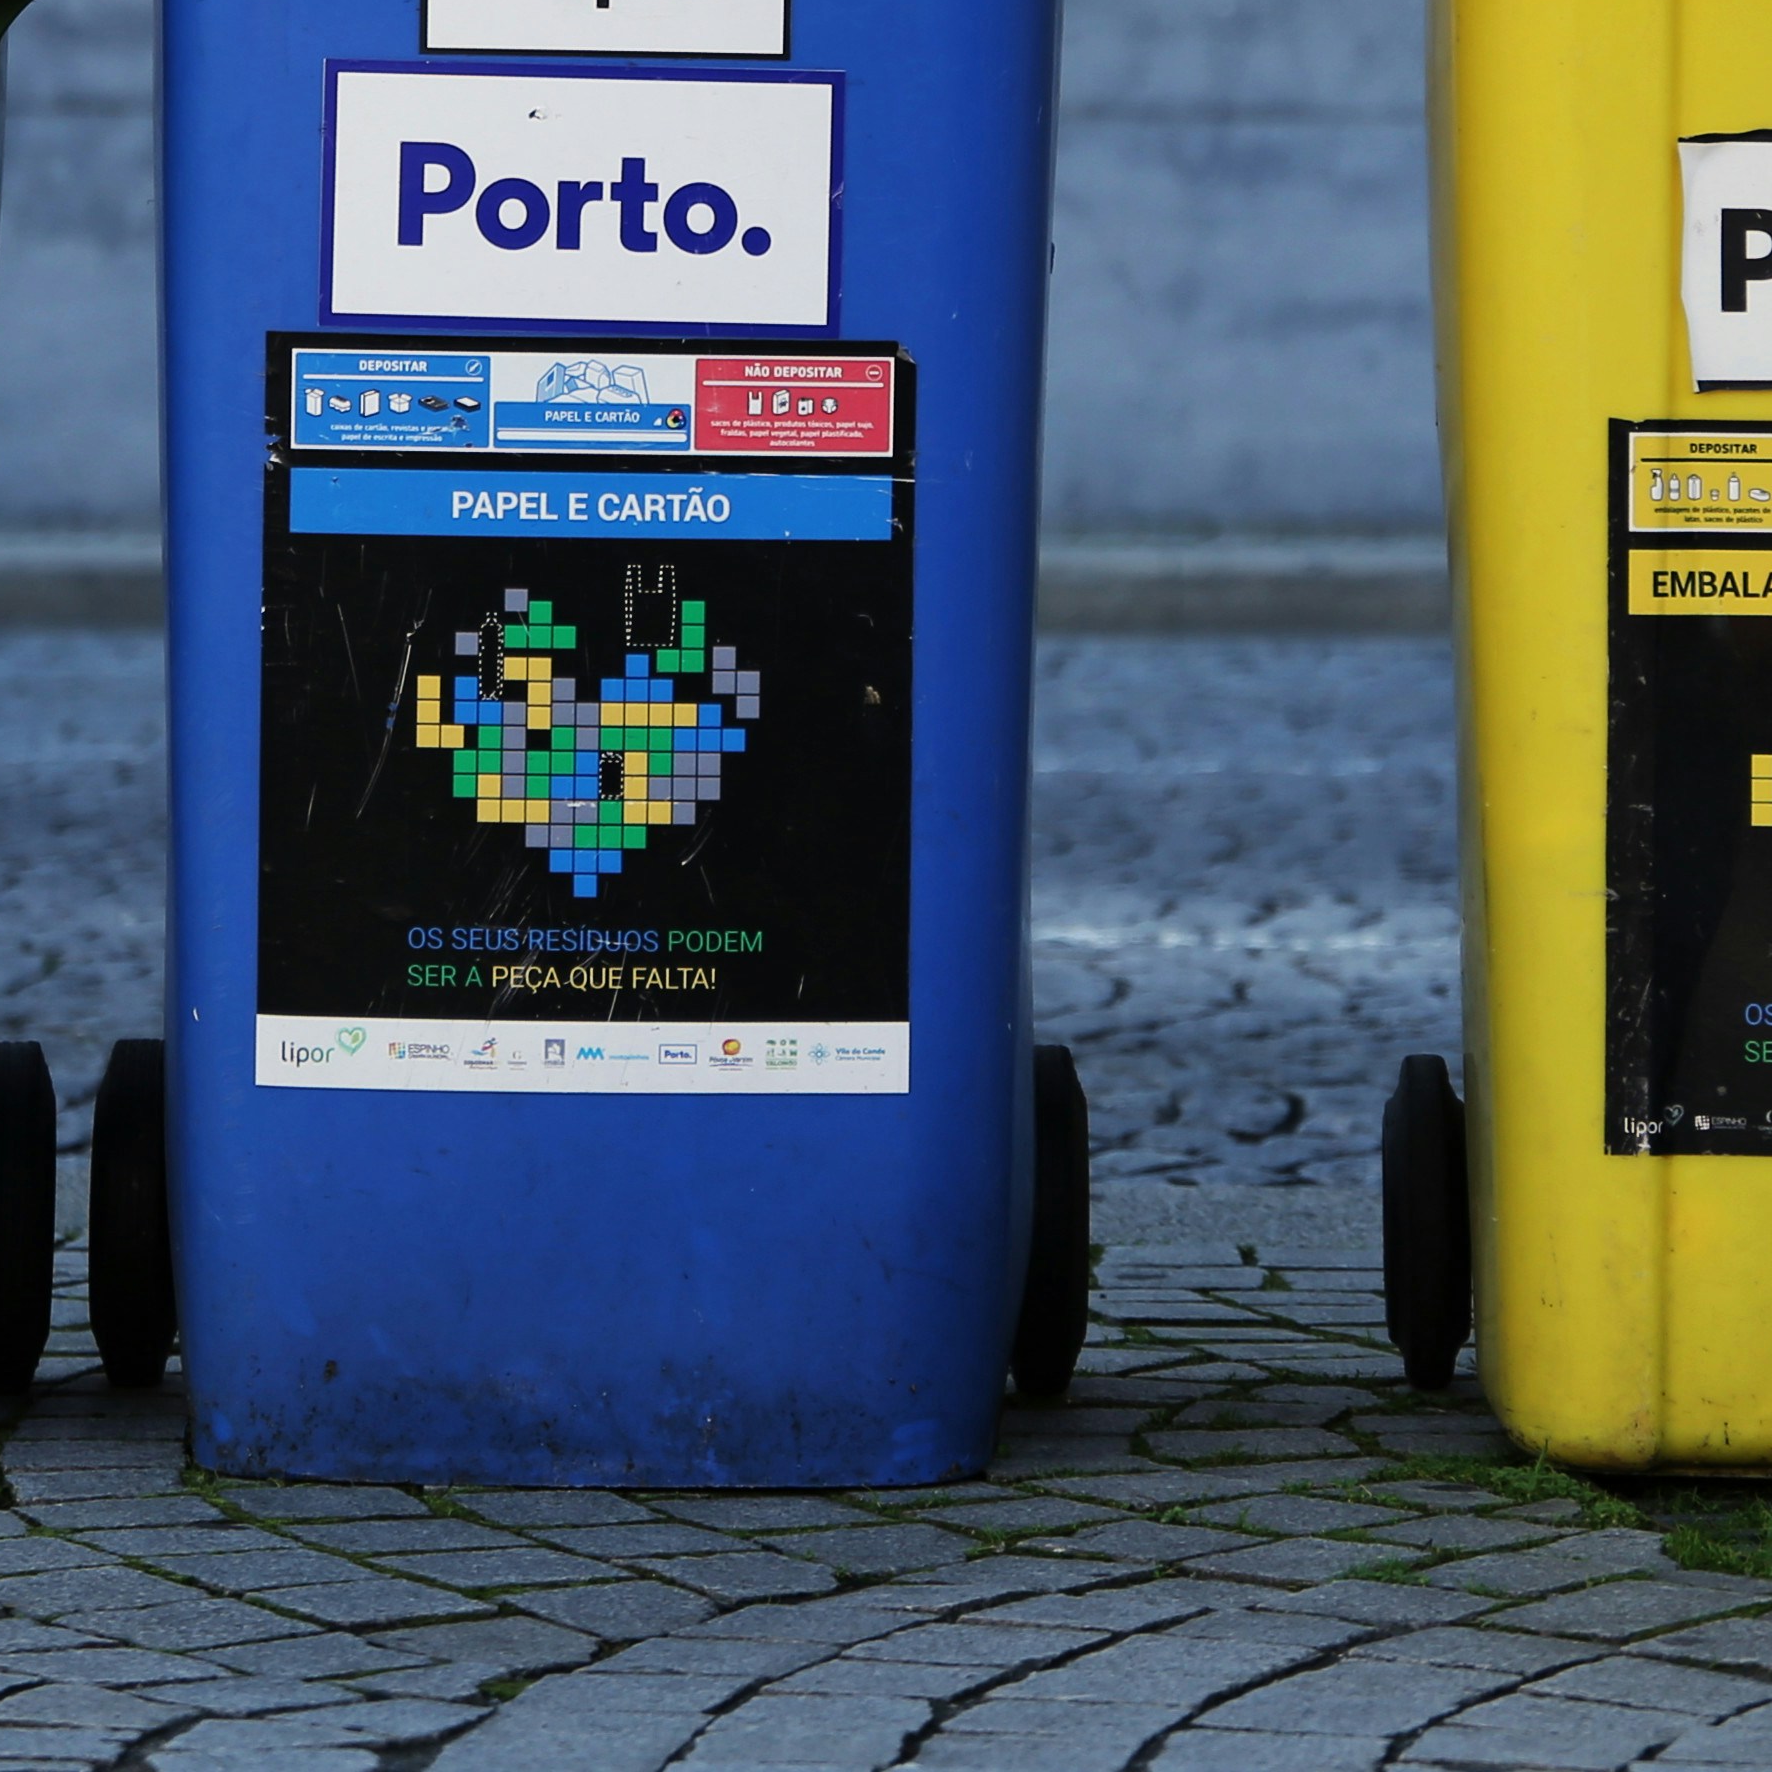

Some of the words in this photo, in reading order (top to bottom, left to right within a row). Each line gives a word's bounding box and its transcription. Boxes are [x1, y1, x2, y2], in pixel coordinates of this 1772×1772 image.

[397, 140, 772, 257] Porto.
[359, 360, 427, 373] DEPOSITAR
[744, 363, 769, 378] NÃO
[774, 365, 842, 379] DEPOSITAR
[545, 410, 581, 422] PAPEL
[585, 411, 592, 422] E
[595, 409, 640, 424] CARTÃO
[354, 423, 363, 431] de
[732, 419, 742, 427] de
[774, 420, 806, 429] produtos
[836, 421, 856, 429] papel
[362, 433, 372, 441] de
[749, 429, 770, 438] papel
[800, 429, 820, 438] papel
[769, 439, 815, 447] autocolantes
[1689, 442, 1758, 455] DEPOSITAR
[451, 490, 559, 521] PAPEL
[568, 493, 589, 521] E
[597, 487, 731, 523] CARTÃO
[1736, 516, 1763, 524] plástico
[407, 927, 443, 950] OS
[451, 928, 520, 951] SEUS
[529, 924, 659, 952] RESÍDUOS
[668, 930, 763, 953] PODEM
[407, 964, 456, 987] SER
[464, 966, 483, 987] A
[491, 966, 561, 994] PEÇA
[569, 966, 623, 991] QUE
[631, 967, 716, 990] FALTA!
[281, 1040, 335, 1068] lipor
[408, 1043, 450, 1055] ESPINHO
[663, 1049, 692, 1059] Porto.
[1624, 1117, 1663, 1138] lipor
[1711, 1116, 1747, 1126] ESPINHO
